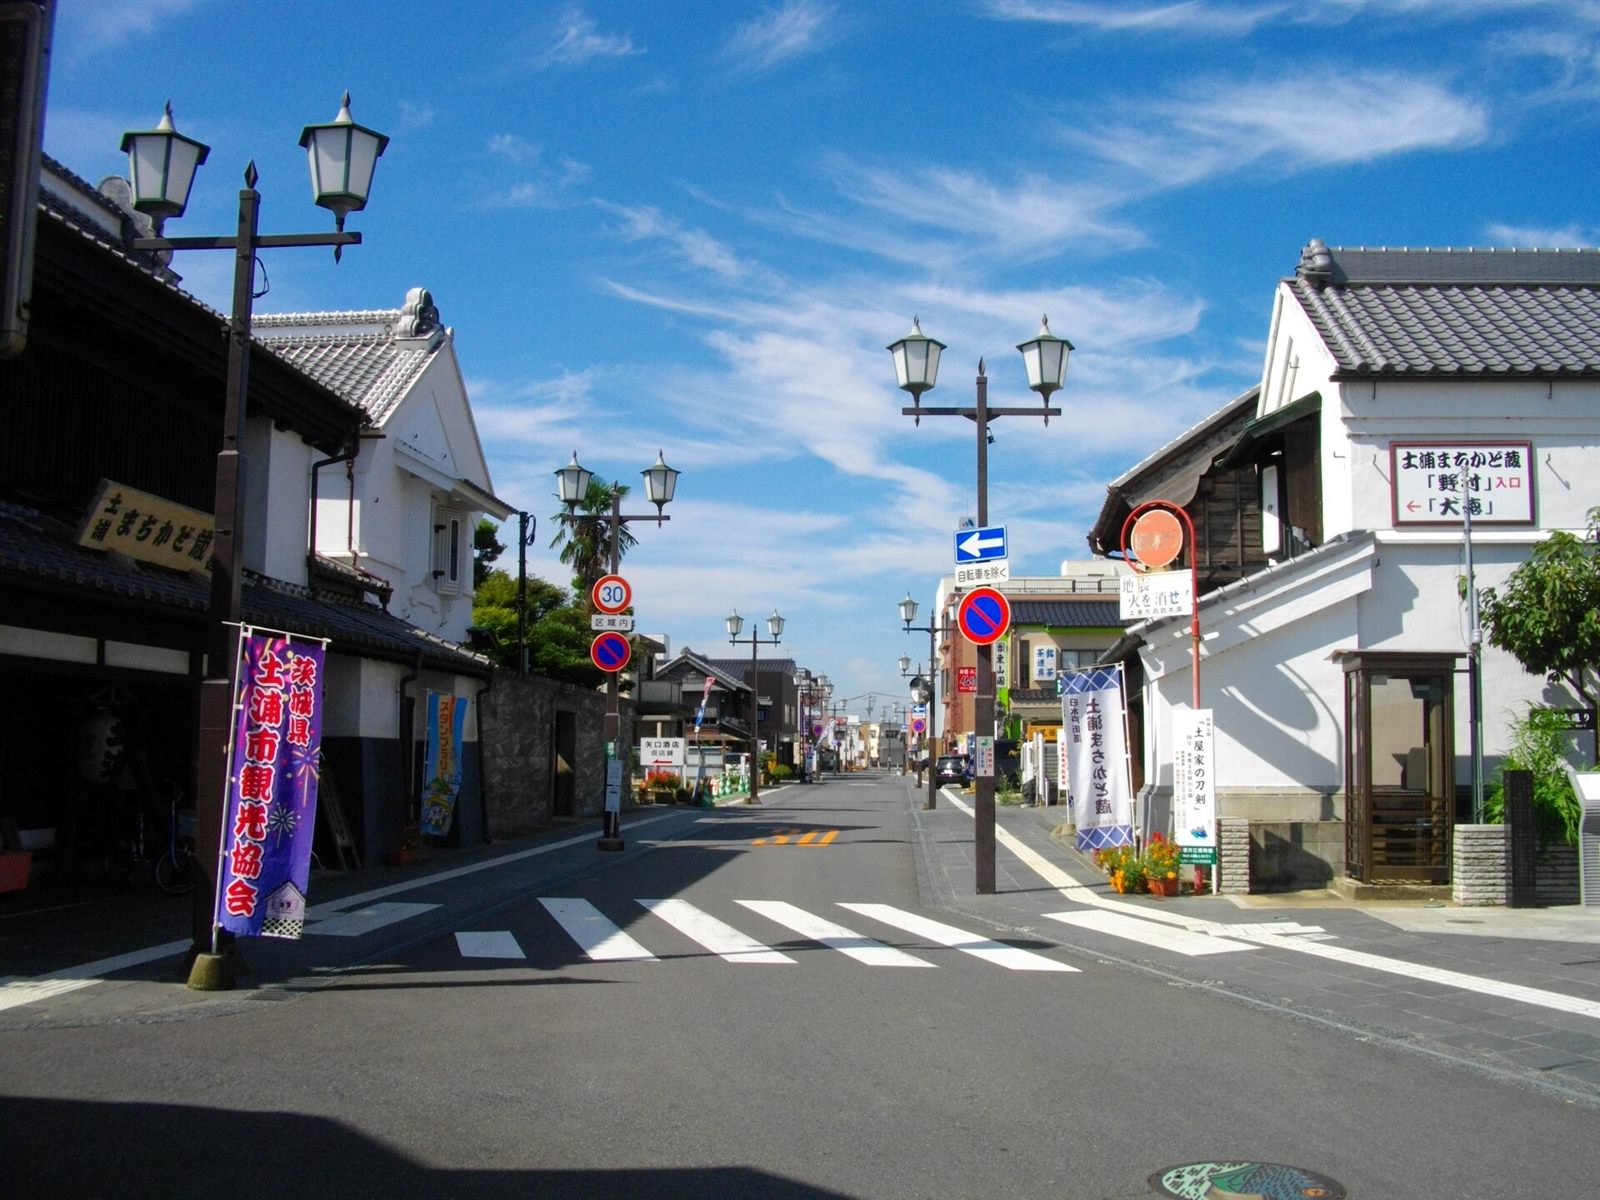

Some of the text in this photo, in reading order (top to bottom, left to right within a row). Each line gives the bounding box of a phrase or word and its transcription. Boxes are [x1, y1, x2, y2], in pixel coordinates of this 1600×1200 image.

[1402, 450, 1521, 470] 土浦まちかど蔵
[1496, 477, 1521, 488] 入口
[958, 566, 1007, 582] 自転車を除く
[602, 586, 623, 603] 30
[595, 618, 629, 627] 区域内
[287, 654, 317, 747] 茨城県
[645, 741, 680, 749] 矢口酒店
[1194, 721, 1206, 810] 「土屋家の刀剣」
[226, 650, 285, 918] 土浦市観光協会
